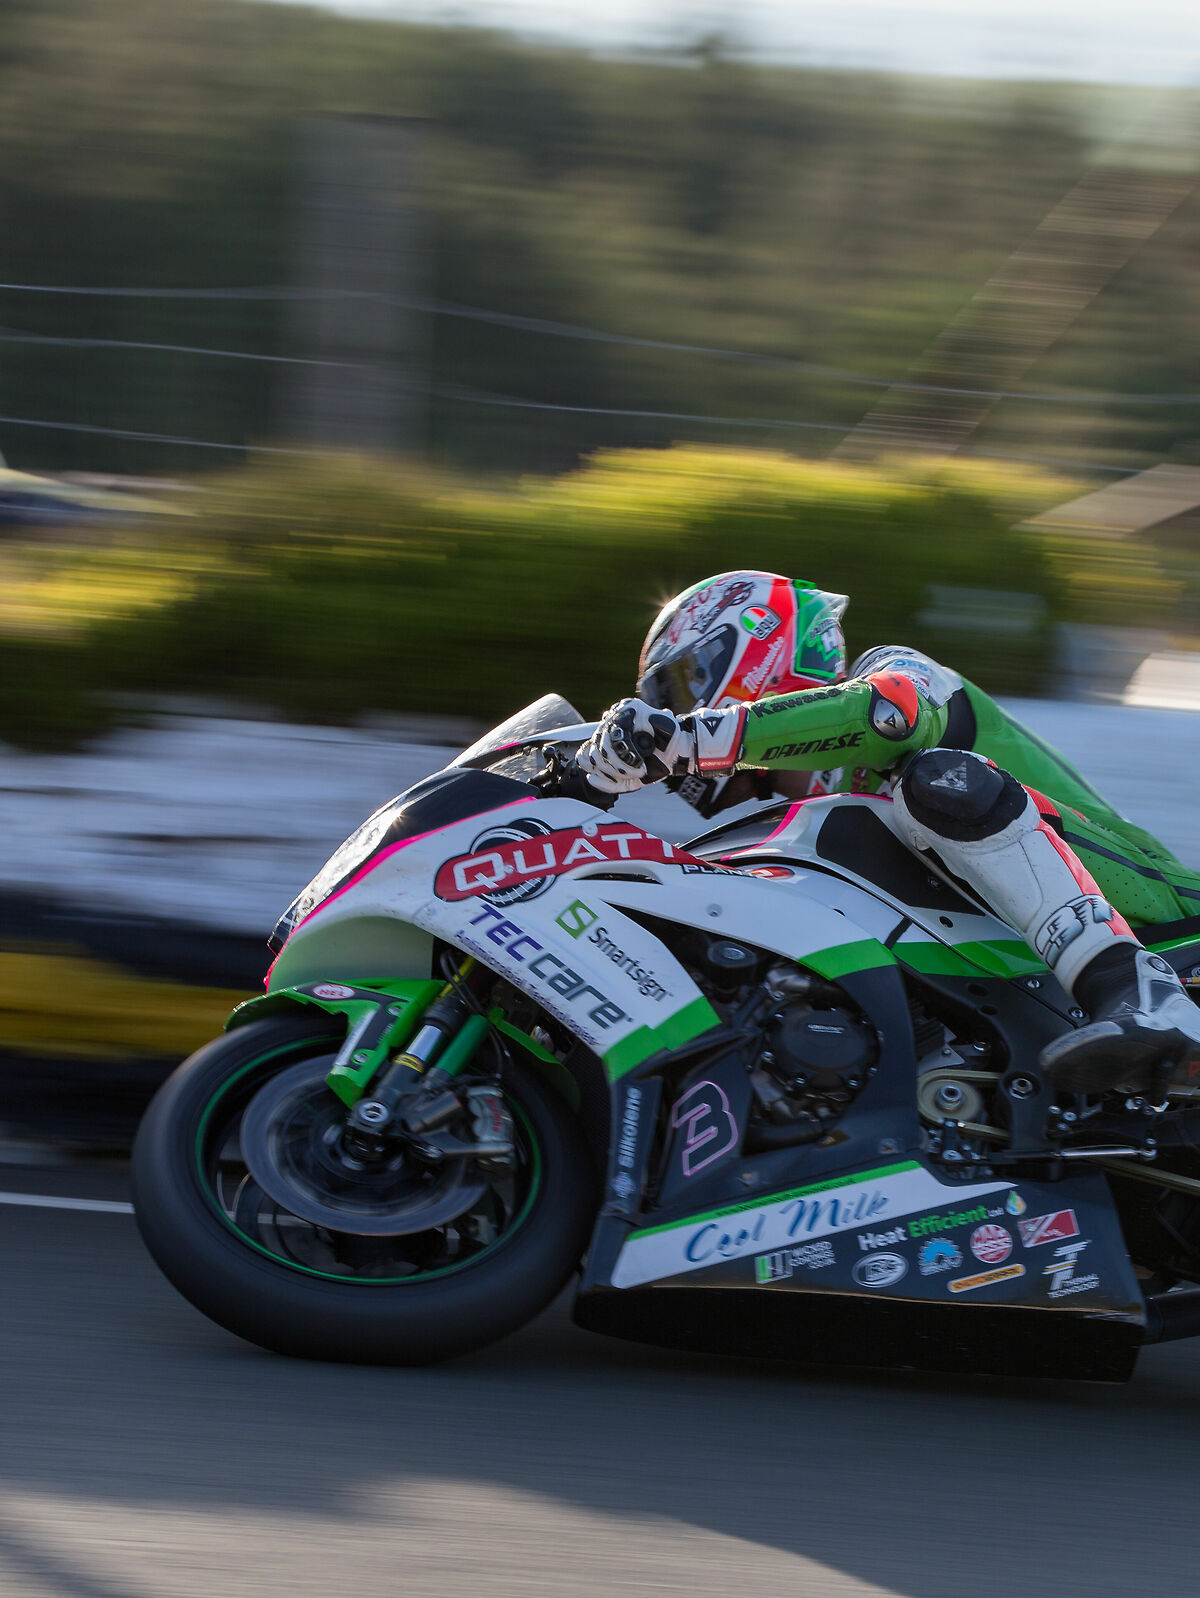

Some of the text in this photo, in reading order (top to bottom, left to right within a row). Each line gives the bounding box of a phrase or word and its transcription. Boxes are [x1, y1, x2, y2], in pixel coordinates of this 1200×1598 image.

[748, 688, 842, 718] Kawasa
[760, 731, 866, 761] DAINESE
[588, 926, 667, 1003] Smartsign
[671, 1080, 738, 1176] 3
[685, 1214, 767, 1263] Cool
[779, 1190, 888, 1238] Milk
